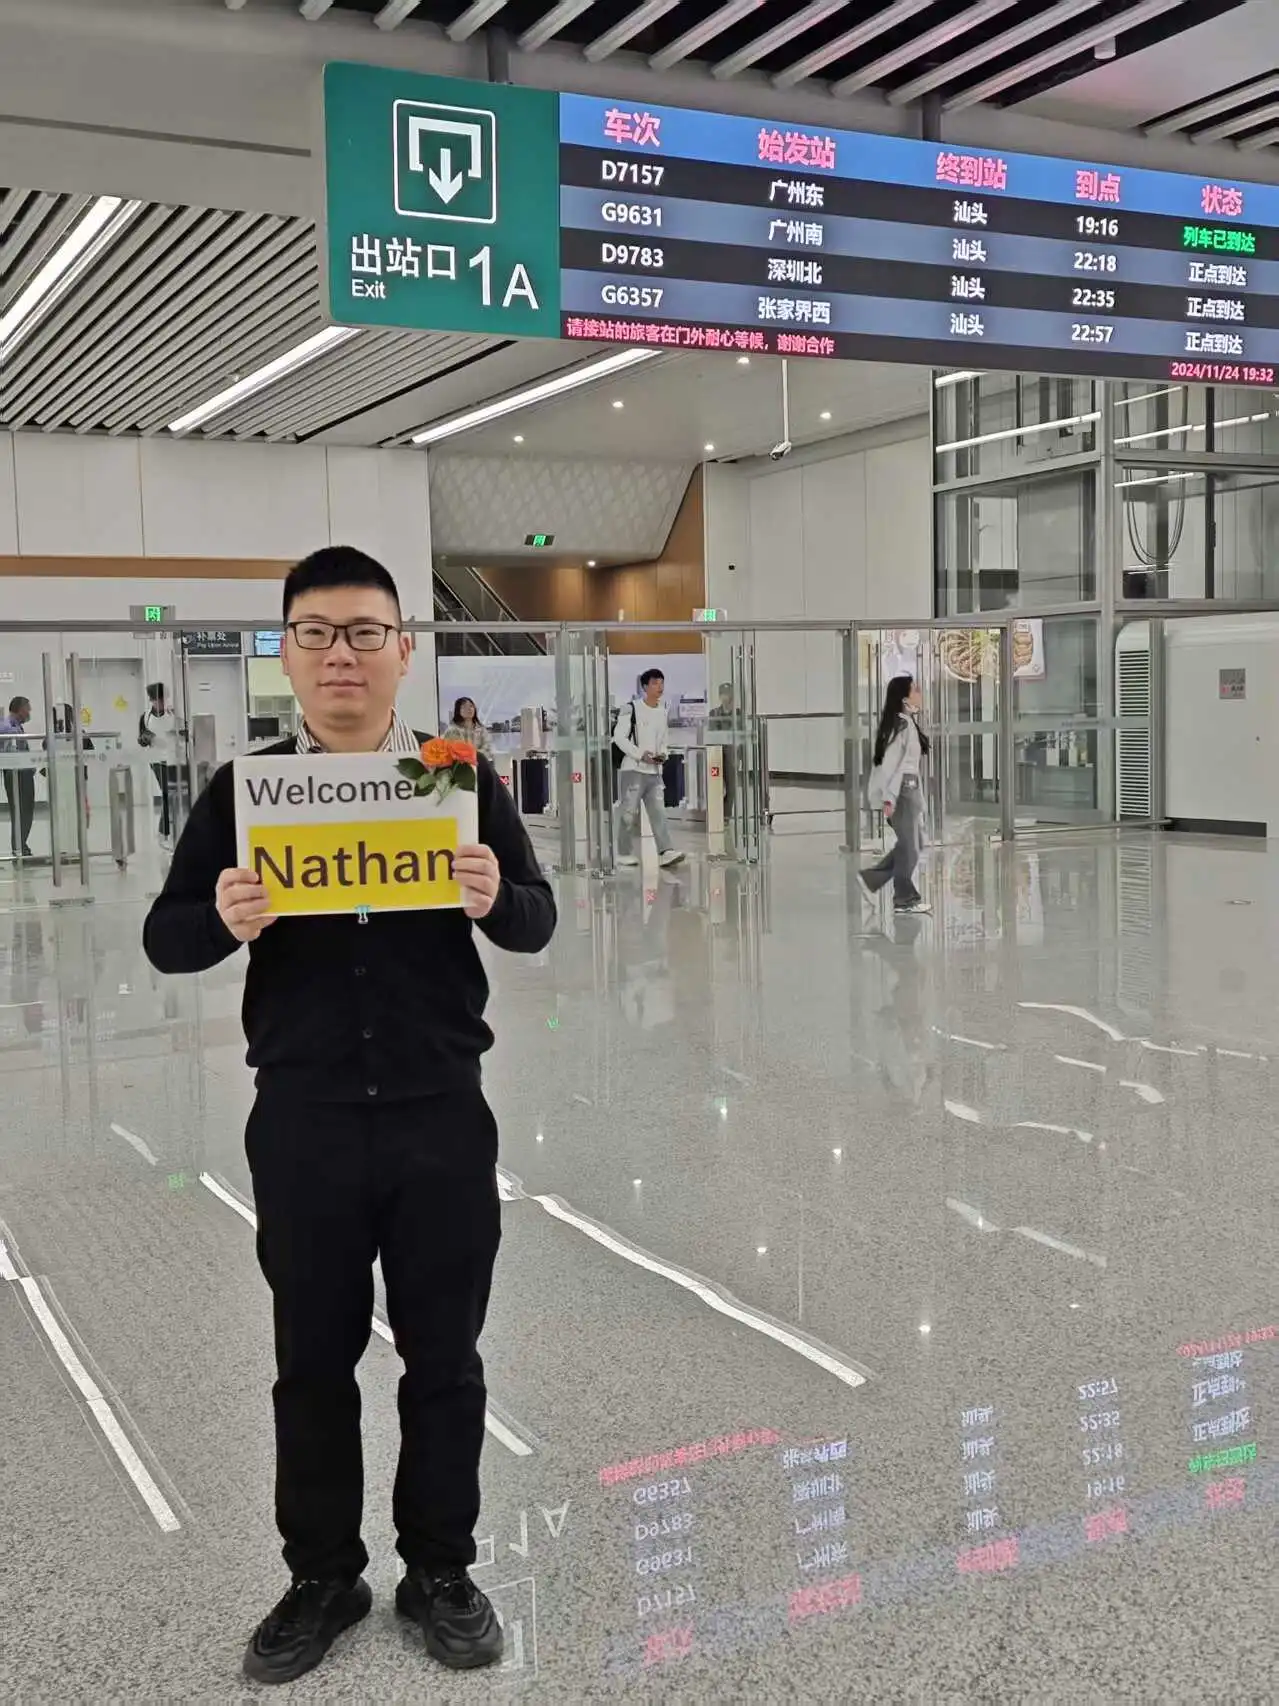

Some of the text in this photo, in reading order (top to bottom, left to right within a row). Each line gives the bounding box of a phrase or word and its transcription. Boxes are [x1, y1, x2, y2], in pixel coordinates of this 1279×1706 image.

[604, 108, 1242, 216] 车次 始发站 终到站 到点 状态
[602, 160, 1256, 253] D7157 广州东 汕头 19:16 列车已到达
[352, 234, 456, 281] 出站口
[601, 203, 1247, 287] G9631 广州南 汕头 22:18 正点到达
[352, 279, 386, 299] Exit
[602, 243, 1245, 321] D9783 深圳北 汕头 22:35 正点到达
[601, 285, 1243, 355] G6357 张家界西 汕头 22:57 正点到达
[1171, 362, 1274, 383] 2024/11/24 19:32
[245, 776, 413, 806] Welcome
[254, 841, 456, 889] Nathan
